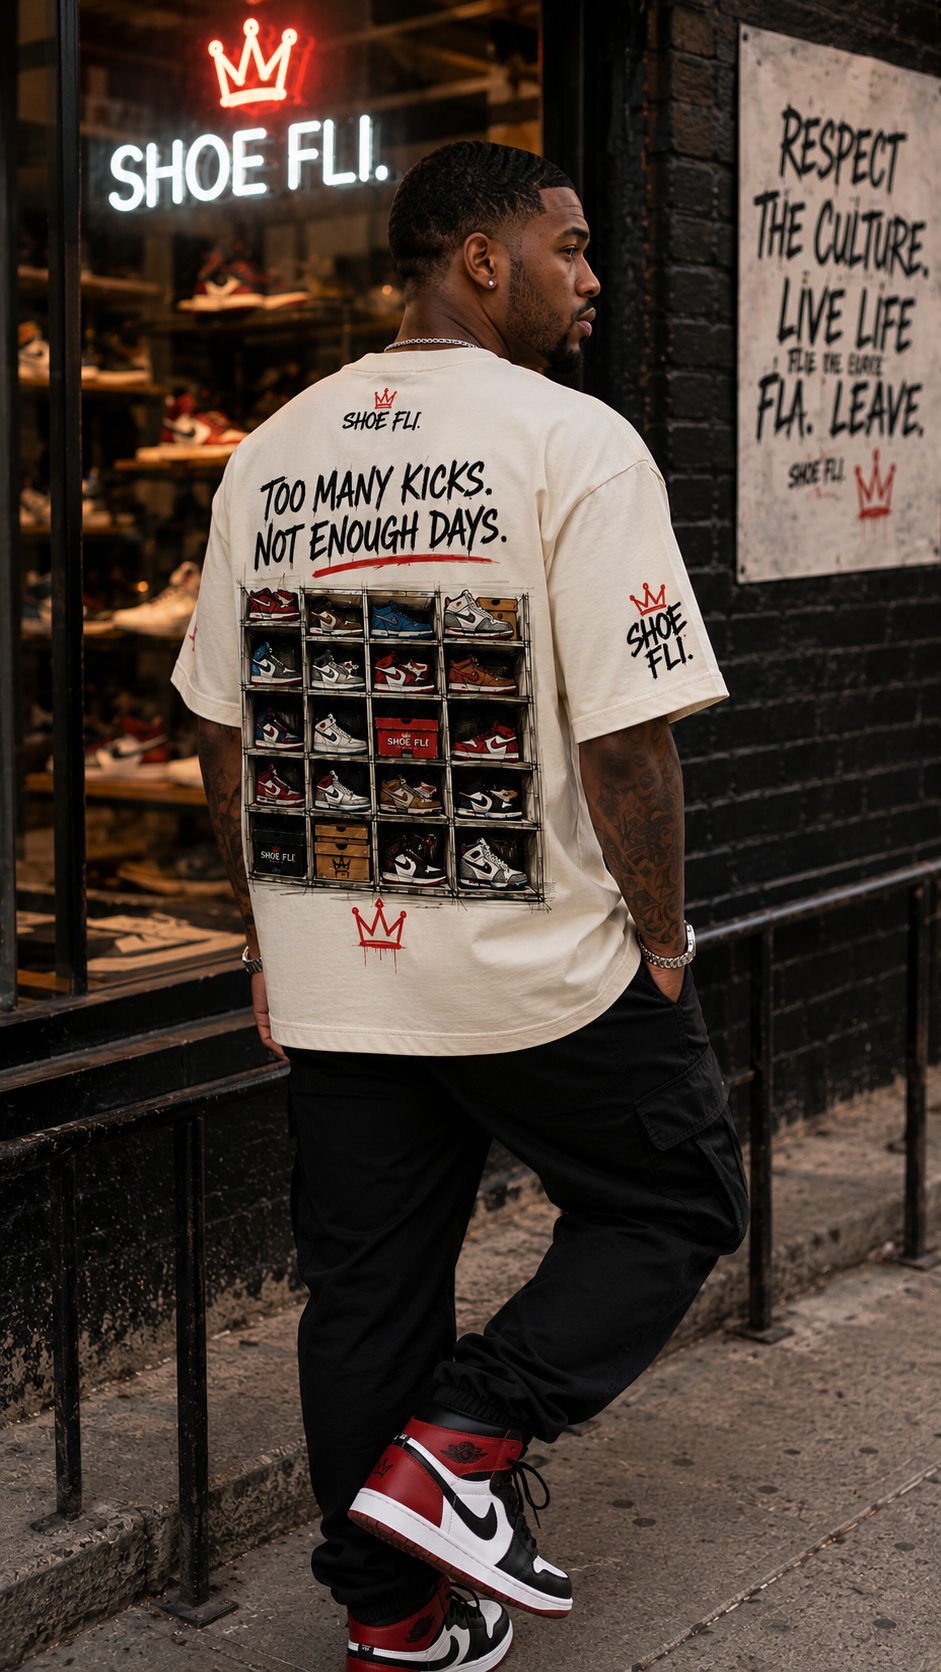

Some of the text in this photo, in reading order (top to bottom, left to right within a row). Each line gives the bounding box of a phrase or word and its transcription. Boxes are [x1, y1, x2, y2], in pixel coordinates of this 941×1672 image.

[108, 114, 389, 212] SHOE FLI.
[780, 105, 908, 195] RESPECT
[754, 190, 929, 278] THE CULTURE.
[777, 276, 917, 354] LIVE LIFE
[342, 411, 422, 432] SHOE FLI.
[757, 372, 813, 442] FLA.
[259, 460, 493, 521] TOO MANY KICKS.
[254, 505, 507, 571] NOT ENOUGH DAYS.
[627, 601, 687, 658] SHOE
[644, 636, 693, 679] FLI.
[387, 737, 411, 747] SHOE
[260, 850, 280, 861] SHOE
